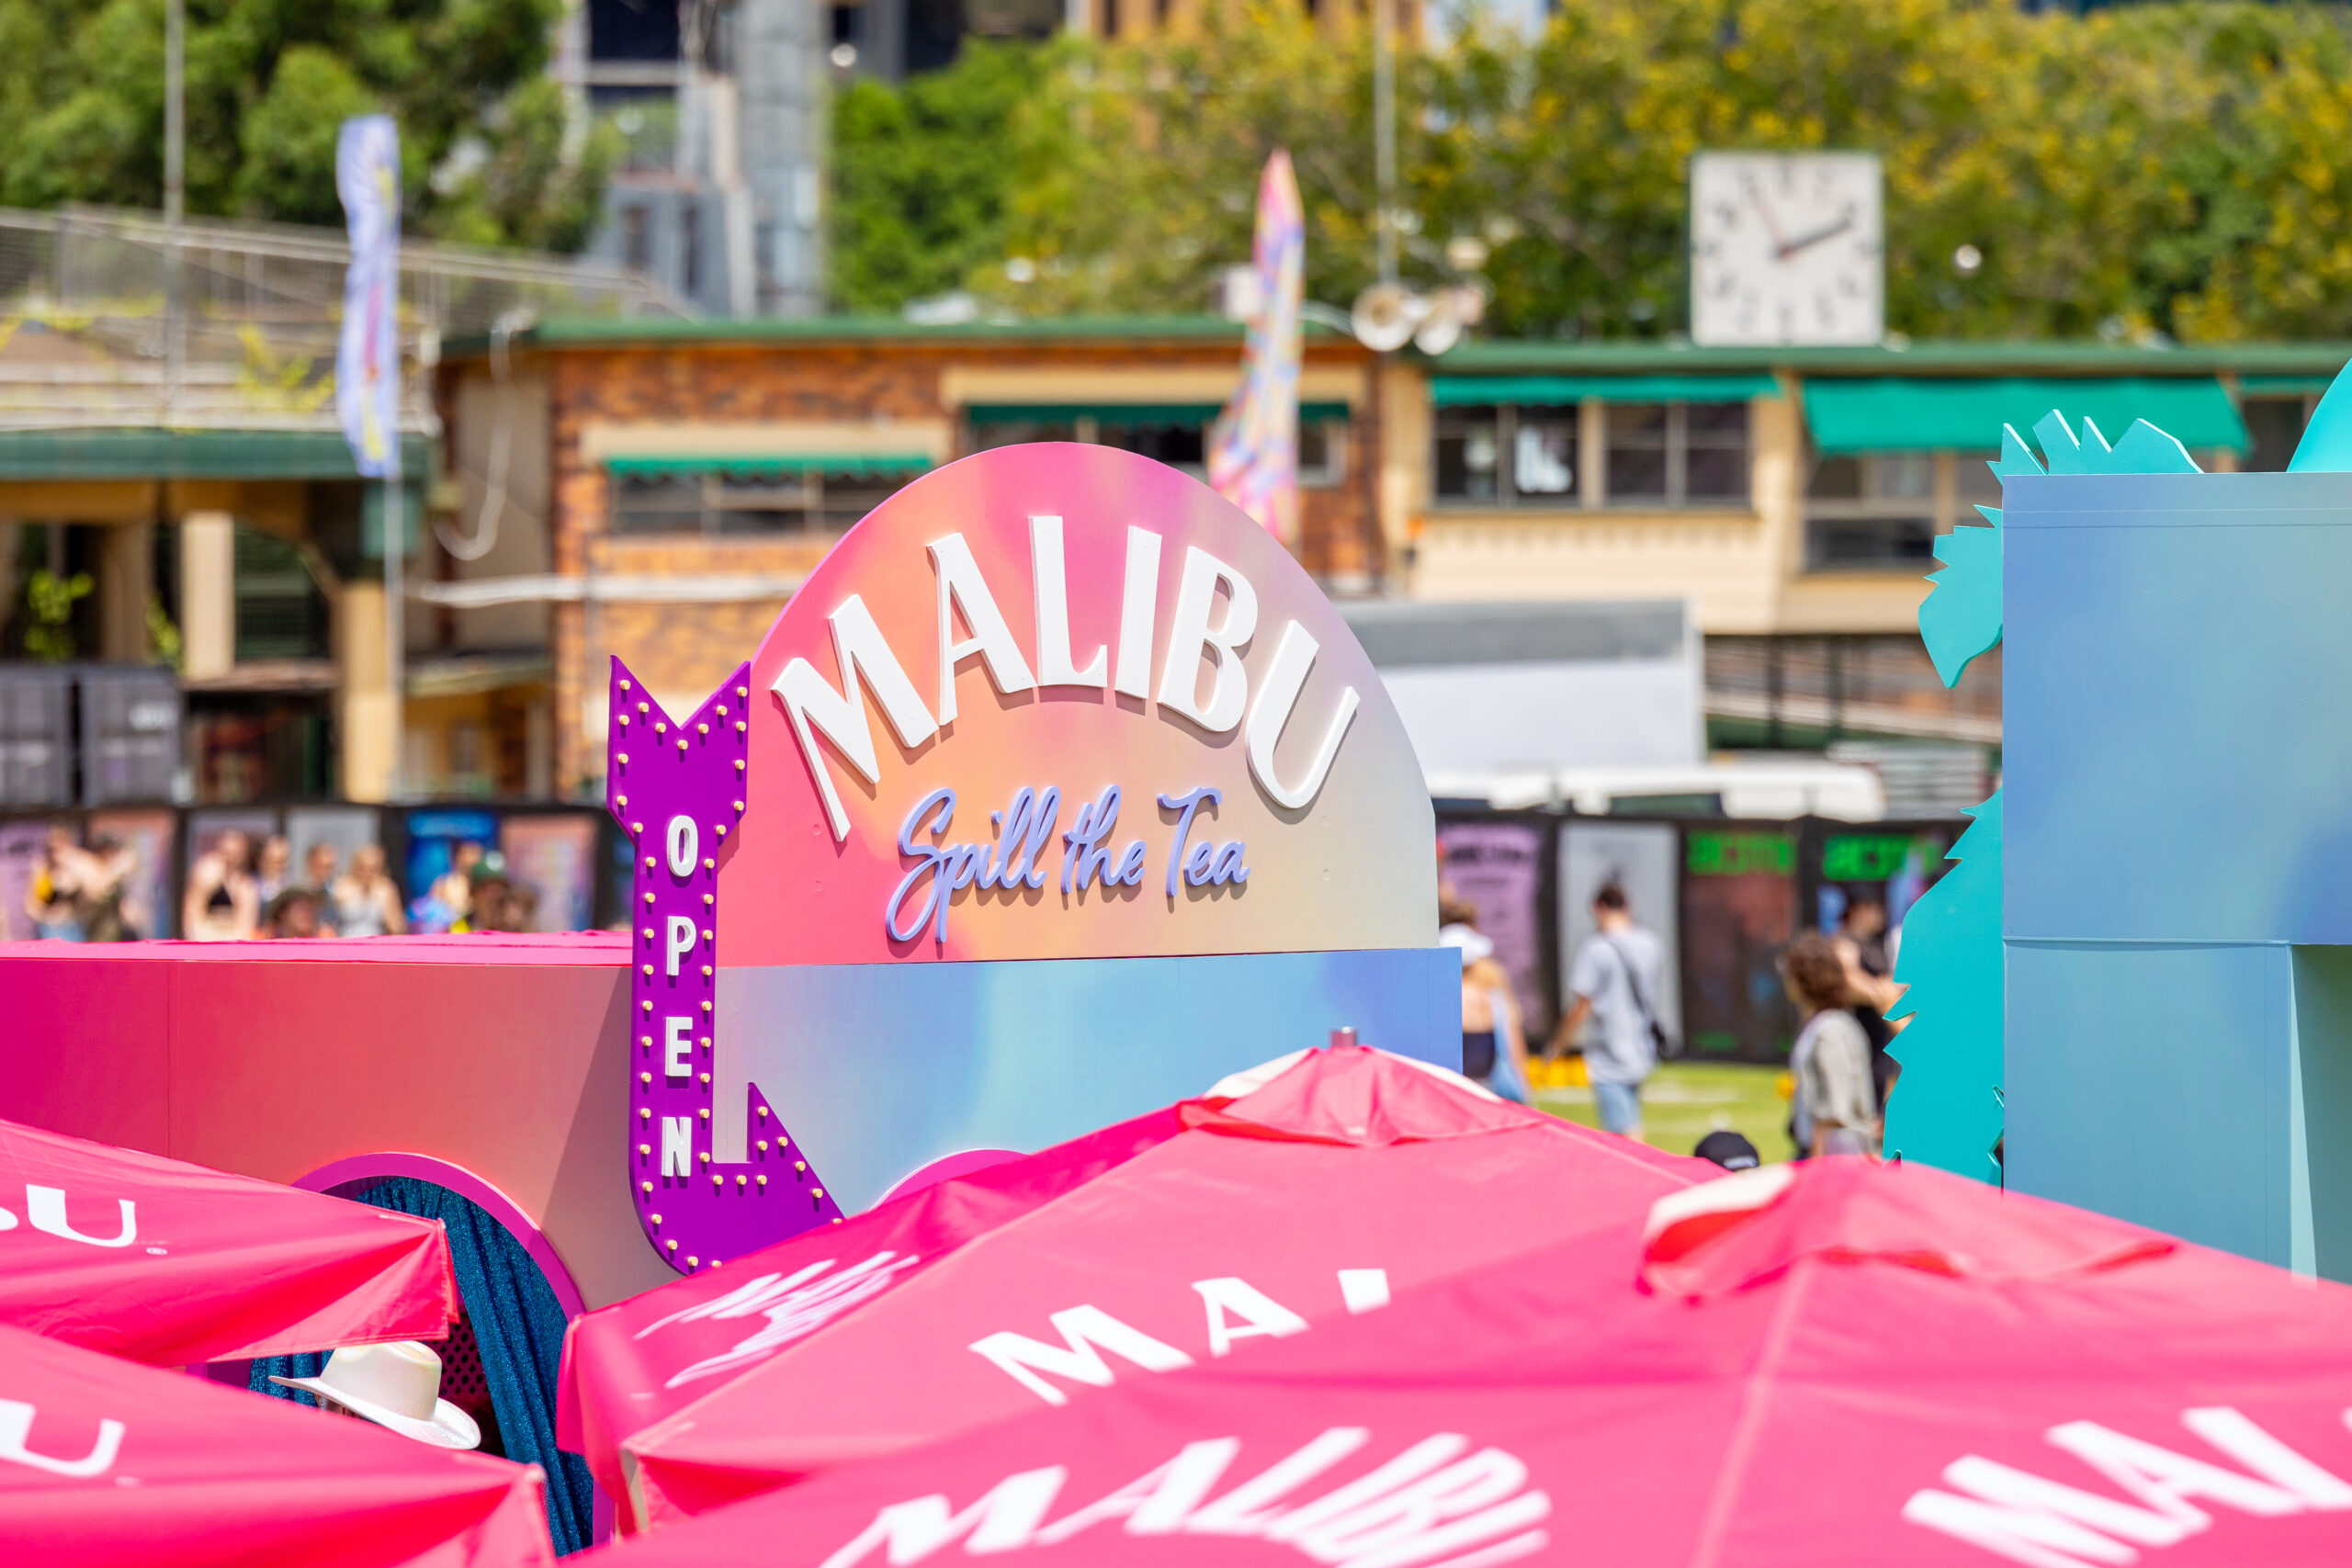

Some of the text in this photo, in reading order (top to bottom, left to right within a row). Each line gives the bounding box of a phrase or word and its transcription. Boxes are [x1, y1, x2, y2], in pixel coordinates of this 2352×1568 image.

[770, 514, 1361, 842] MALIBU
[661, 814, 699, 1179] OPEN
[885, 784, 1251, 943] Spill the Tea
